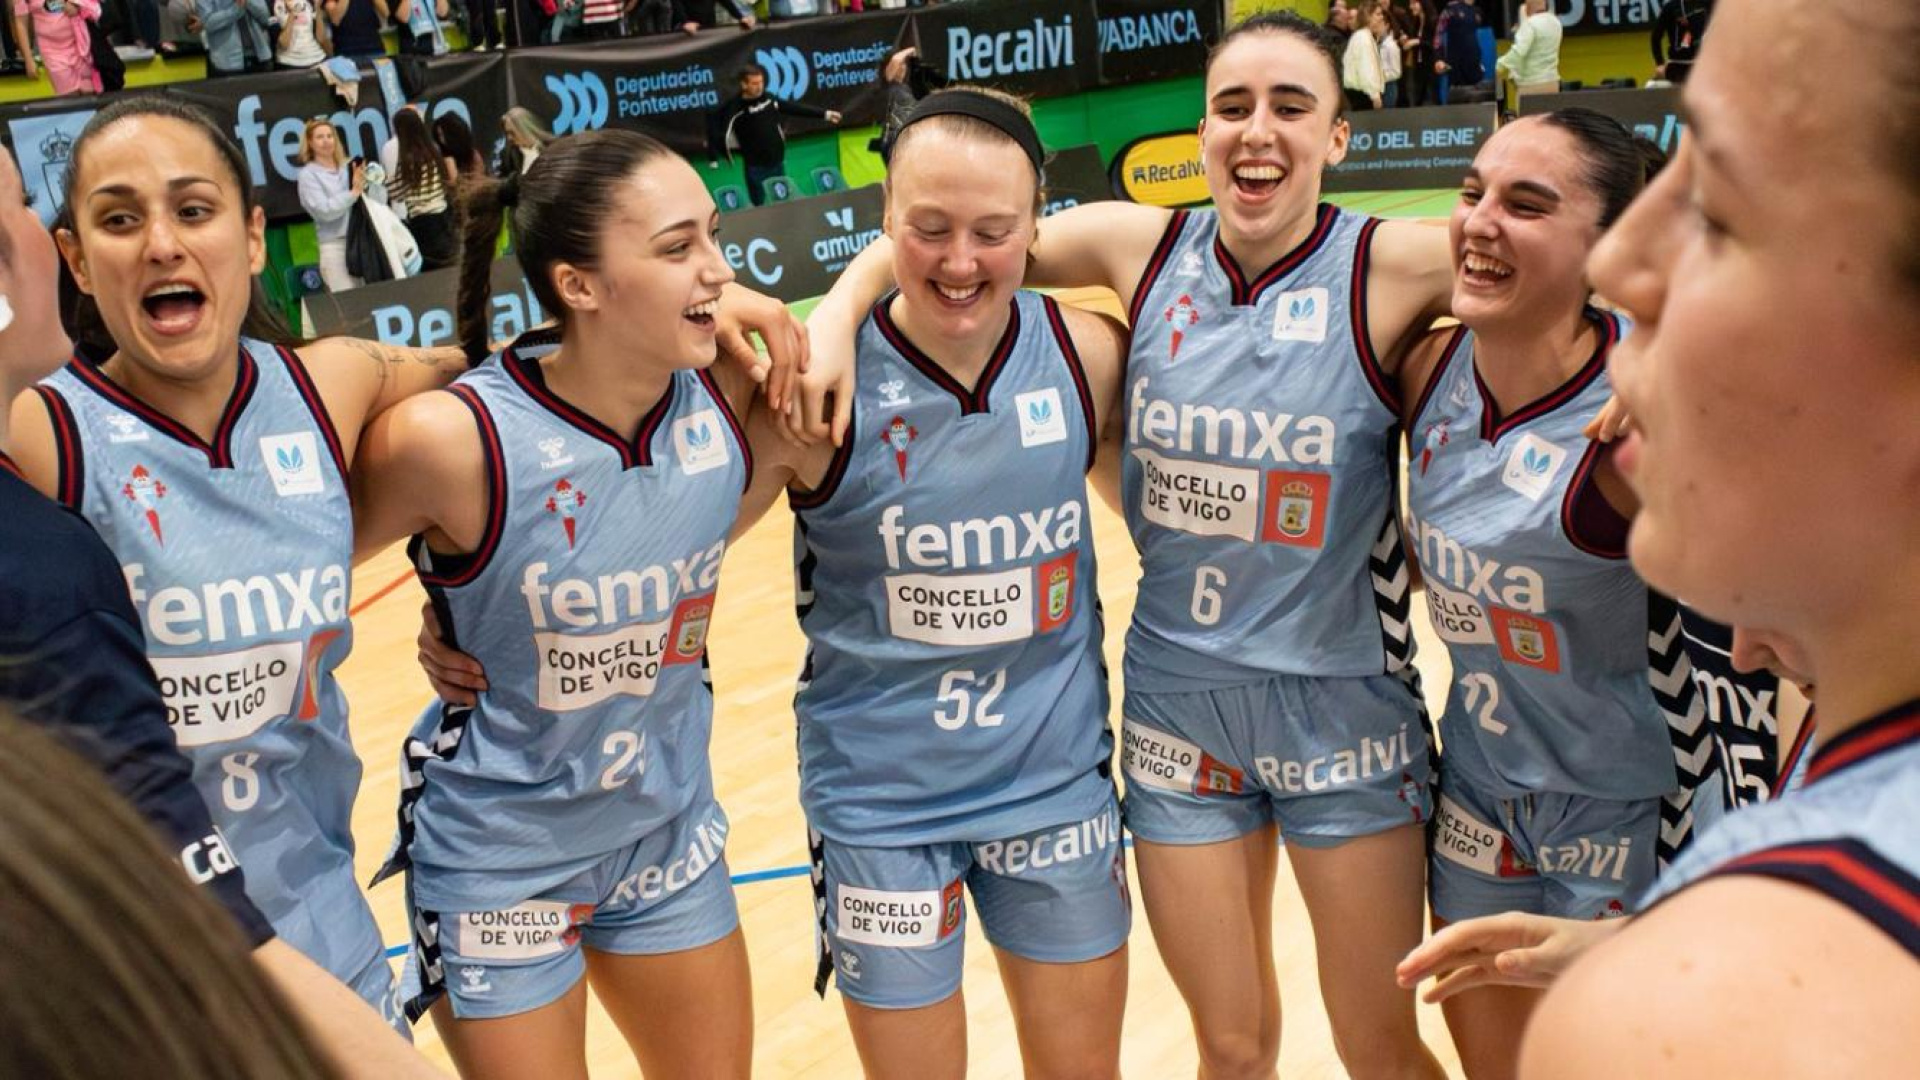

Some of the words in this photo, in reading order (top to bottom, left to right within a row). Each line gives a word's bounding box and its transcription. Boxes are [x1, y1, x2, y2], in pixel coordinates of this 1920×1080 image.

[947, 14, 1075, 80] Recalvi
[1106, 9, 1201, 52] ABANCA
[615, 64, 713, 97] Deputación
[816, 69, 879, 88] Ponteve
[618, 86, 718, 117] Pontevedra
[235, 94, 472, 187] fem
[1377, 131, 1415, 149] DEL
[1421, 128, 1475, 148] BENE
[1130, 377, 1336, 465] femxa
[1146, 461, 1247, 502] CONCELLO
[1148, 489, 1170, 512] DE
[1178, 498, 1232, 521] VIGO
[878, 500, 1082, 569] femxa
[520, 540, 726, 628] femxa
[898, 584, 1021, 607] CONCELLO
[1191, 565, 1227, 626] 6
[913, 610, 942, 629] DE
[951, 609, 1007, 631] VIGO
[548, 633, 668, 670] CONCELLO
[561, 675, 594, 695] DE
[603, 661, 658, 684] VIGO
[166, 704, 202, 727] DE
[212, 686, 266, 722] VIGO
[933, 668, 1007, 731] 52
[1122, 727, 1192, 767] ONCELLO
[1255, 723, 1412, 793] Recalvi
[221, 751, 260, 812] 8
[1140, 756, 1175, 779] VIGO
[1444, 831, 1478, 858] VIGO
[468, 911, 560, 926] CONCELLO
[843, 896, 932, 917] CONCELLO
[481, 931, 507, 945] DE
[852, 916, 872, 932] DE
[878, 920, 922, 935] VIGO
